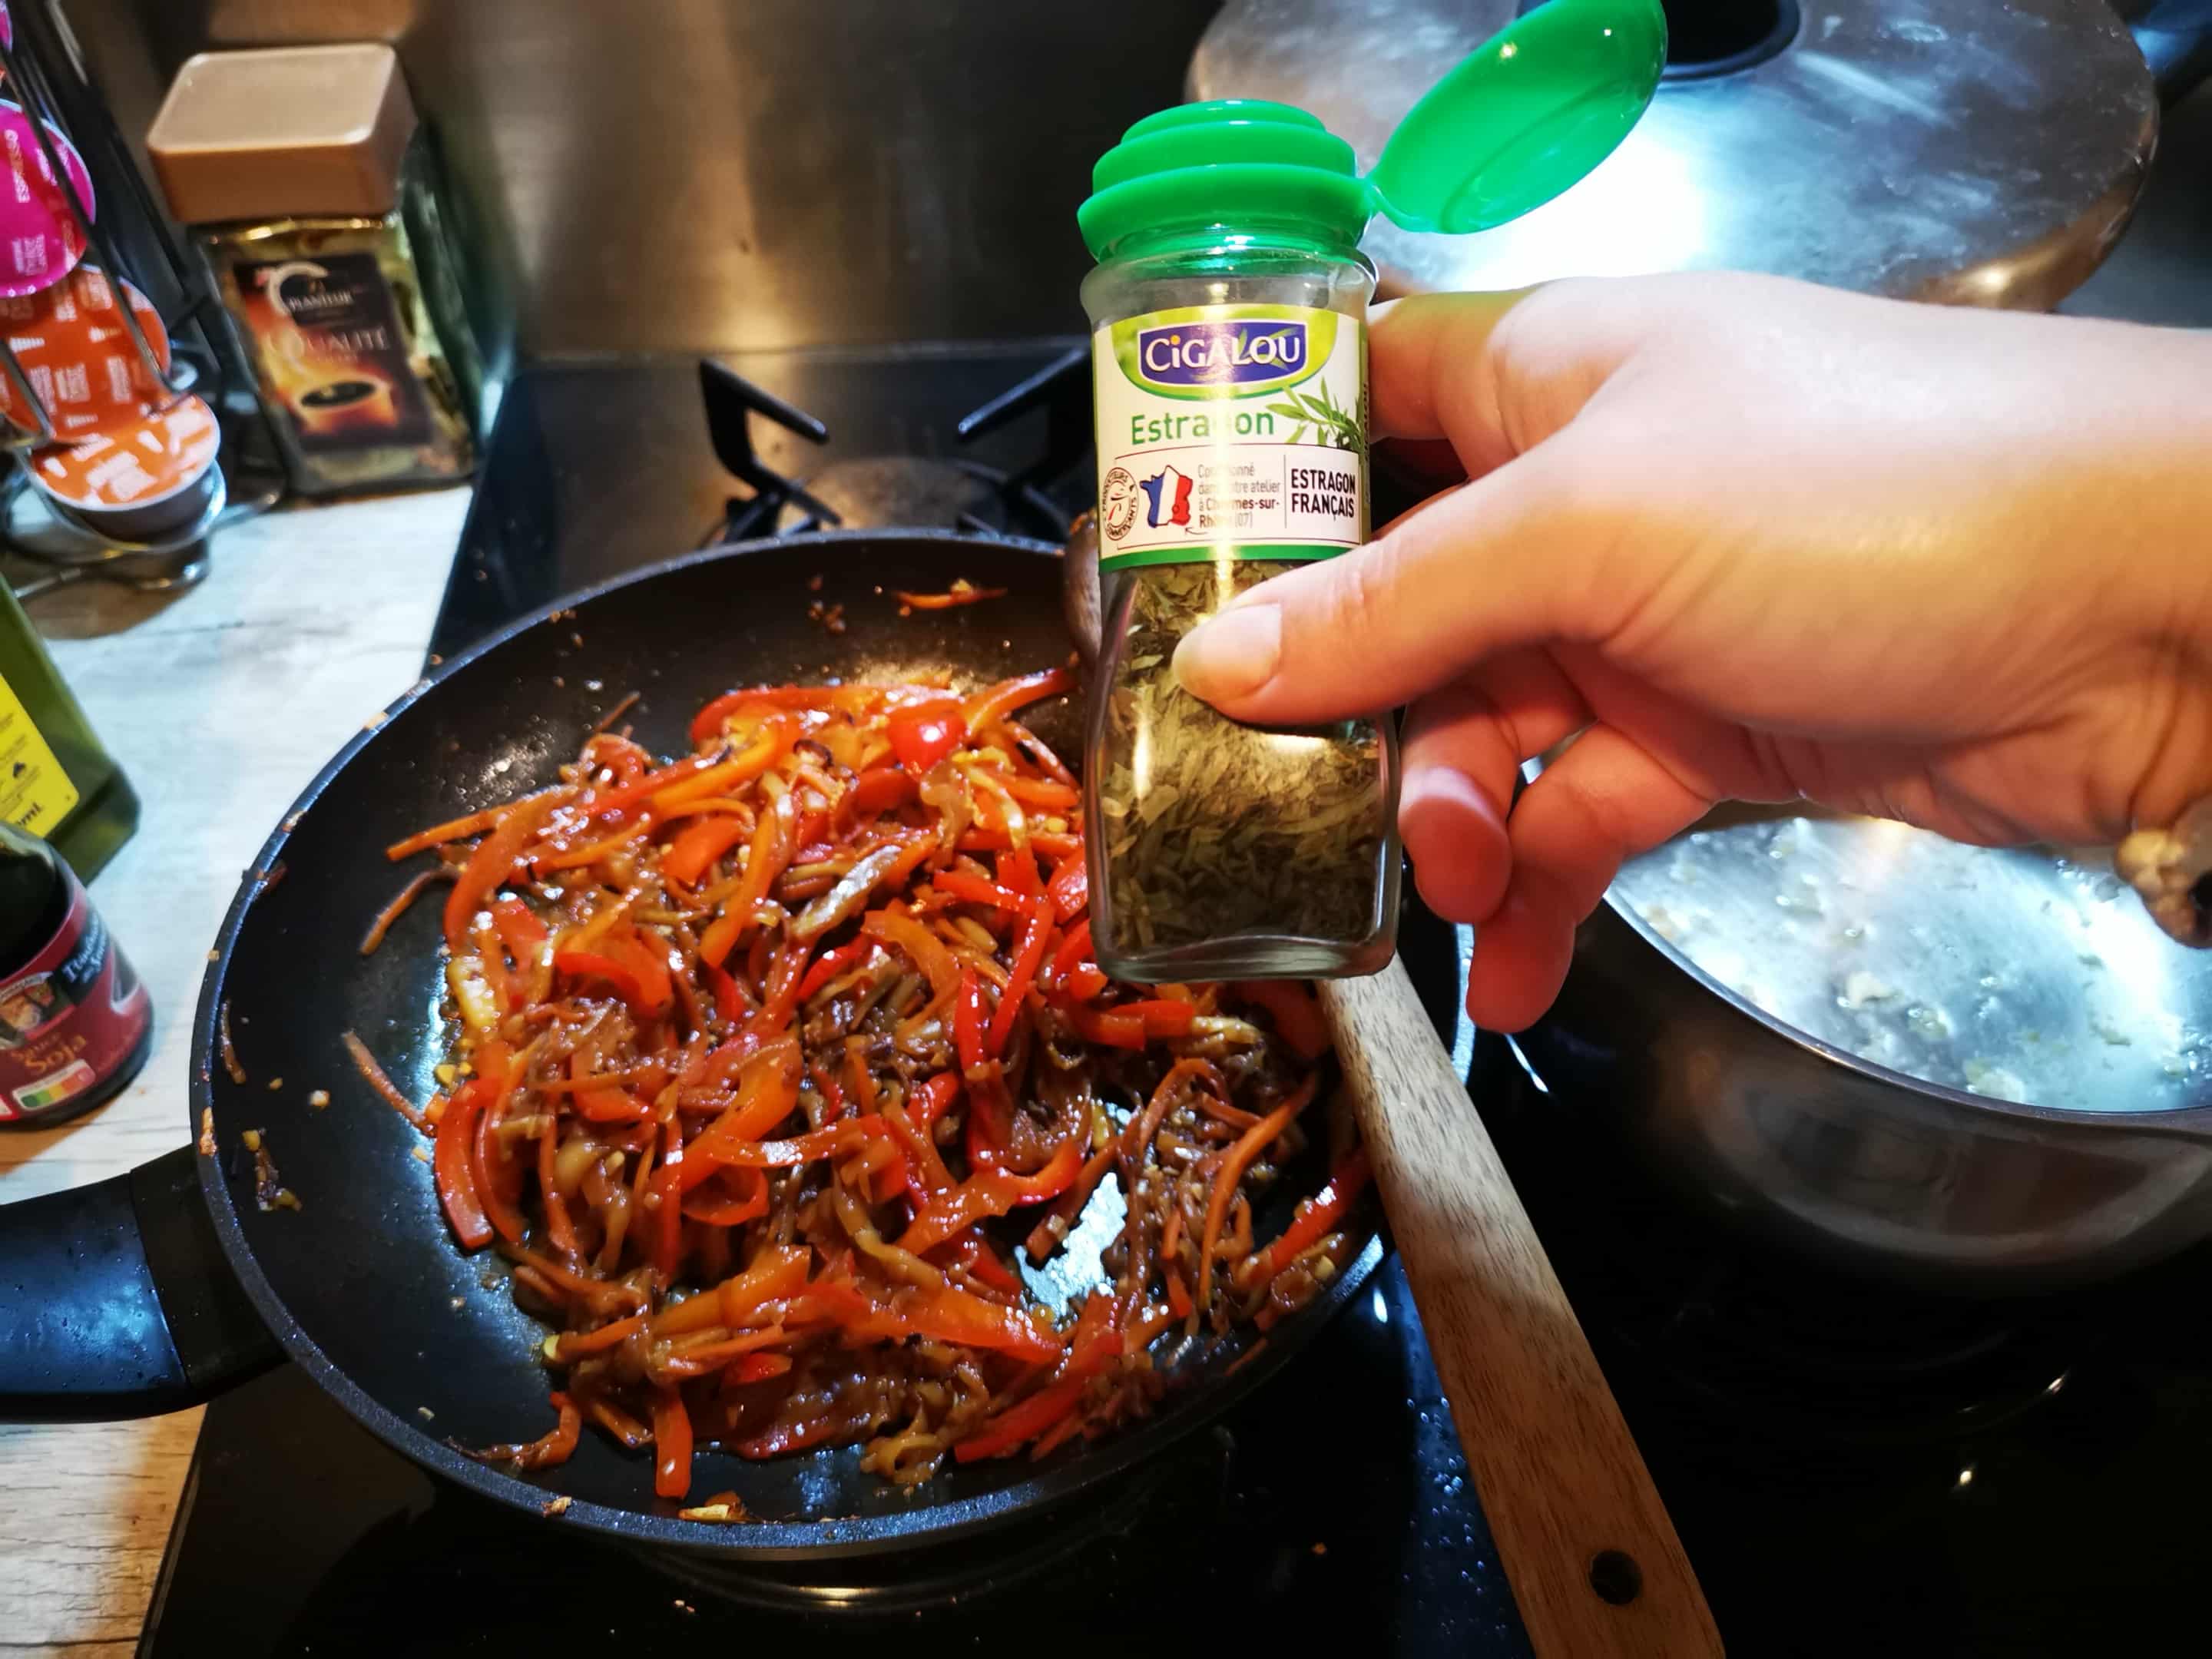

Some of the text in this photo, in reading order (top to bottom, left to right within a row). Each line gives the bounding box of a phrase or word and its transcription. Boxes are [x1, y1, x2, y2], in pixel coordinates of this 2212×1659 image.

[1131, 412, 1274, 445] Estraon
[1291, 468, 1356, 495] ESTRAGON
[1292, 492, 1355, 521] FRANÇAIS
